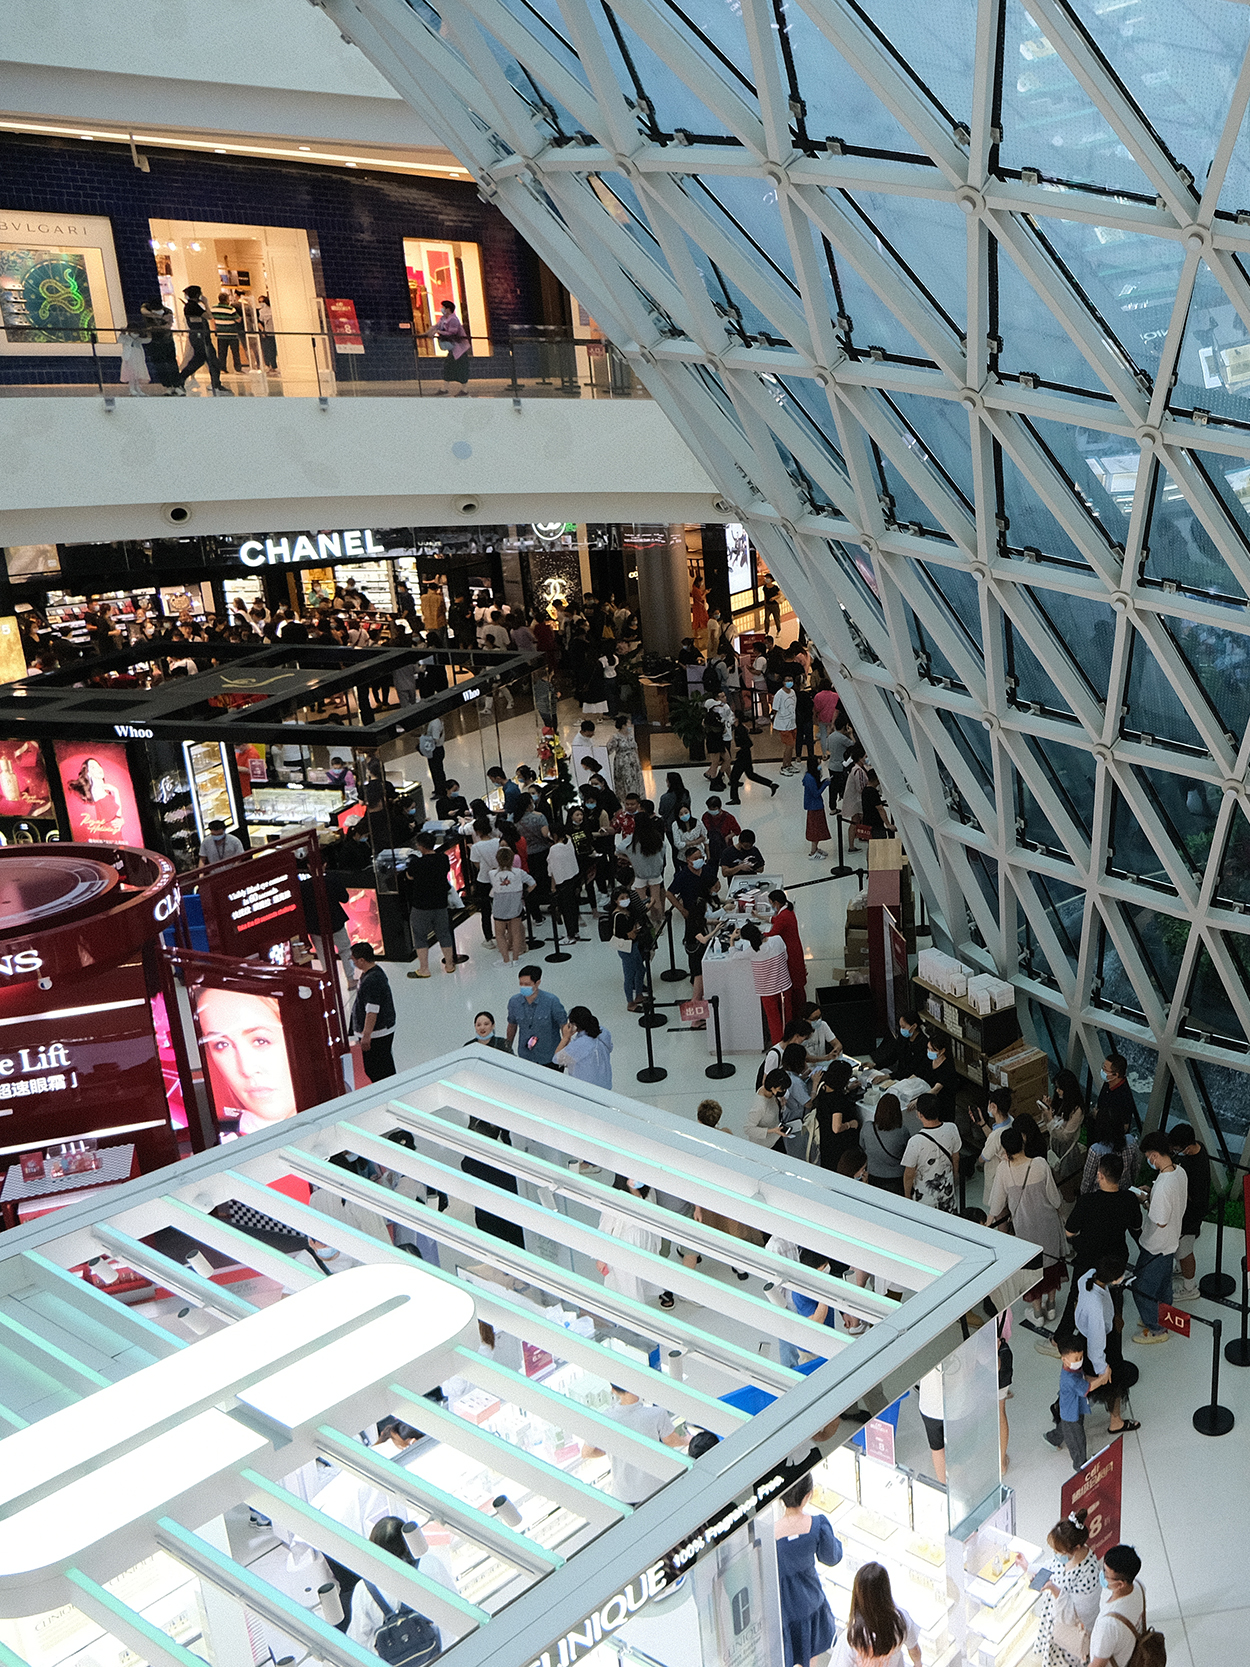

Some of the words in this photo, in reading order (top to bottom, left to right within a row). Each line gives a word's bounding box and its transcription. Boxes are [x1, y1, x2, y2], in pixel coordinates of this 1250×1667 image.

[0, 222, 88, 235] BVLGARI
[239, 529, 385, 567] CHANEL
[114, 725, 154, 739] Whoo
[686, 1006, 704, 1016] 出口
[18, 1043, 71, 1072] Lift
[1164, 1312, 1184, 1328] 入口
[1085, 1461, 1101, 1482] cdf
[529, 1560, 667, 1667] LINIQUE
[673, 1536, 705, 1568] 100%
[705, 1495, 758, 1543] Fragrance
